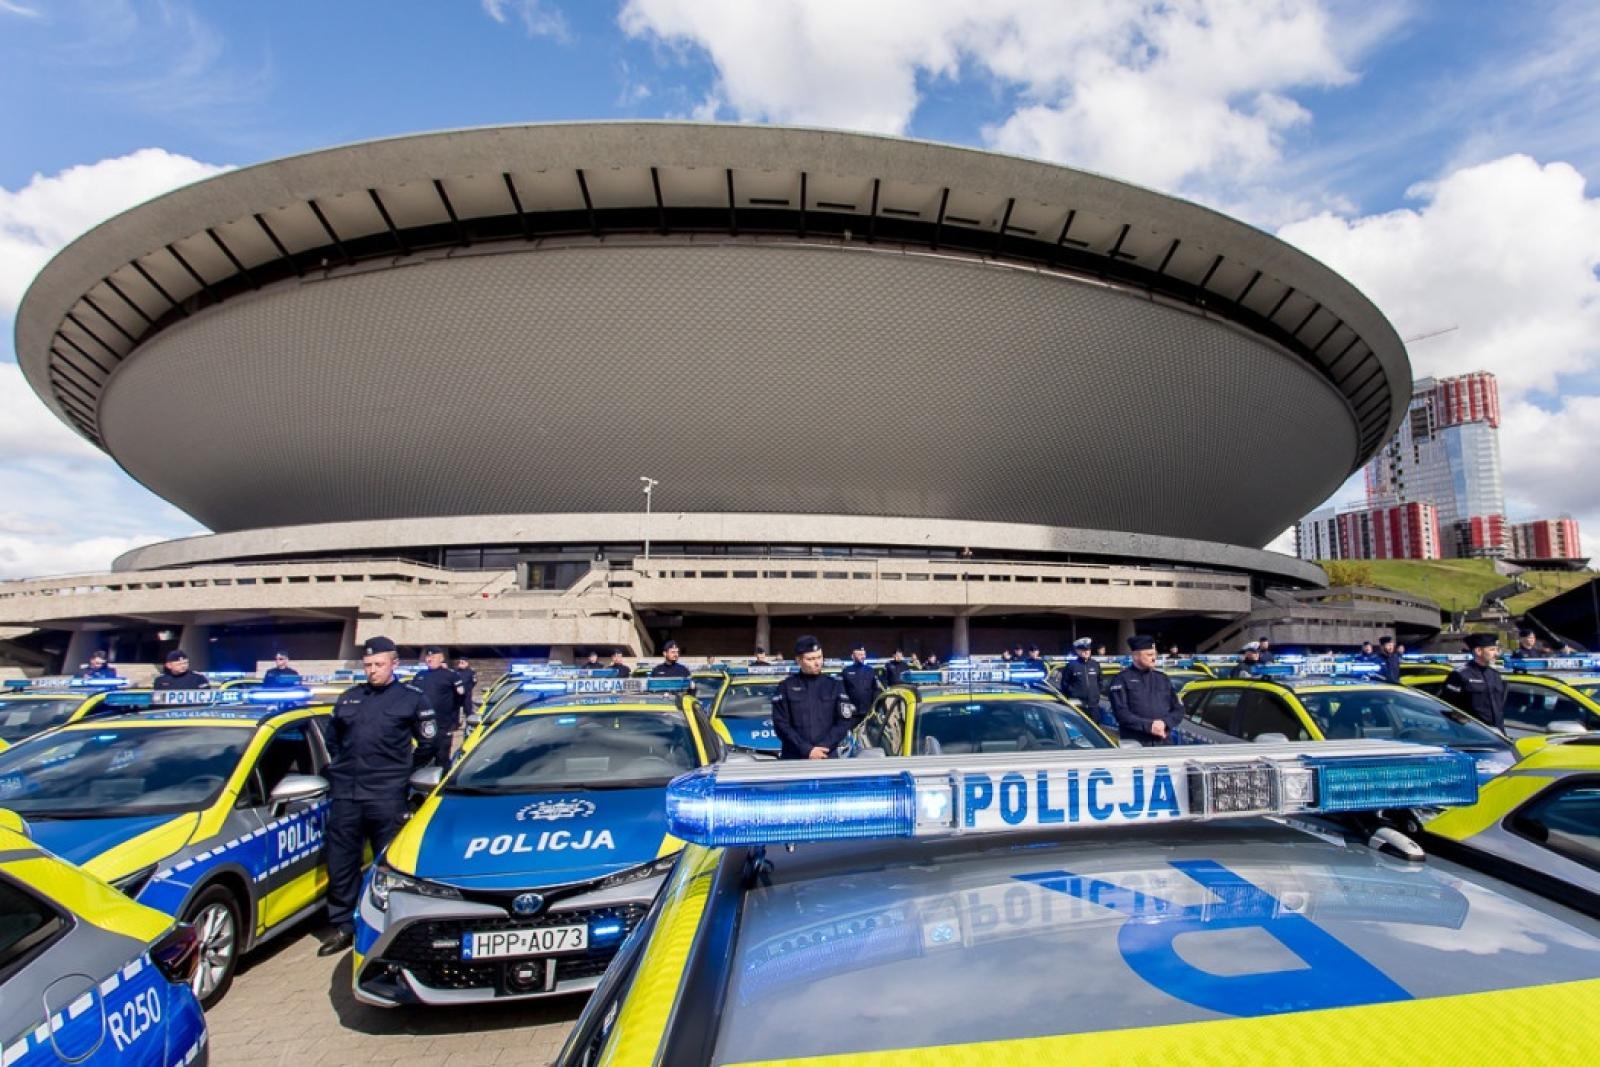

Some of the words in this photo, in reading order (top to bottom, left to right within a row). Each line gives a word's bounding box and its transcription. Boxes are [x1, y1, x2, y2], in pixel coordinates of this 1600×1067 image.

[168, 691, 220, 703] POLICJA
[577, 679, 625, 692] POLICJA
[963, 764, 1180, 828] POLICJA
[464, 830, 616, 859] POLICJA
[477, 932, 519, 955] HPP
[528, 928, 582, 951] A073
[107, 986, 161, 1052] R250
